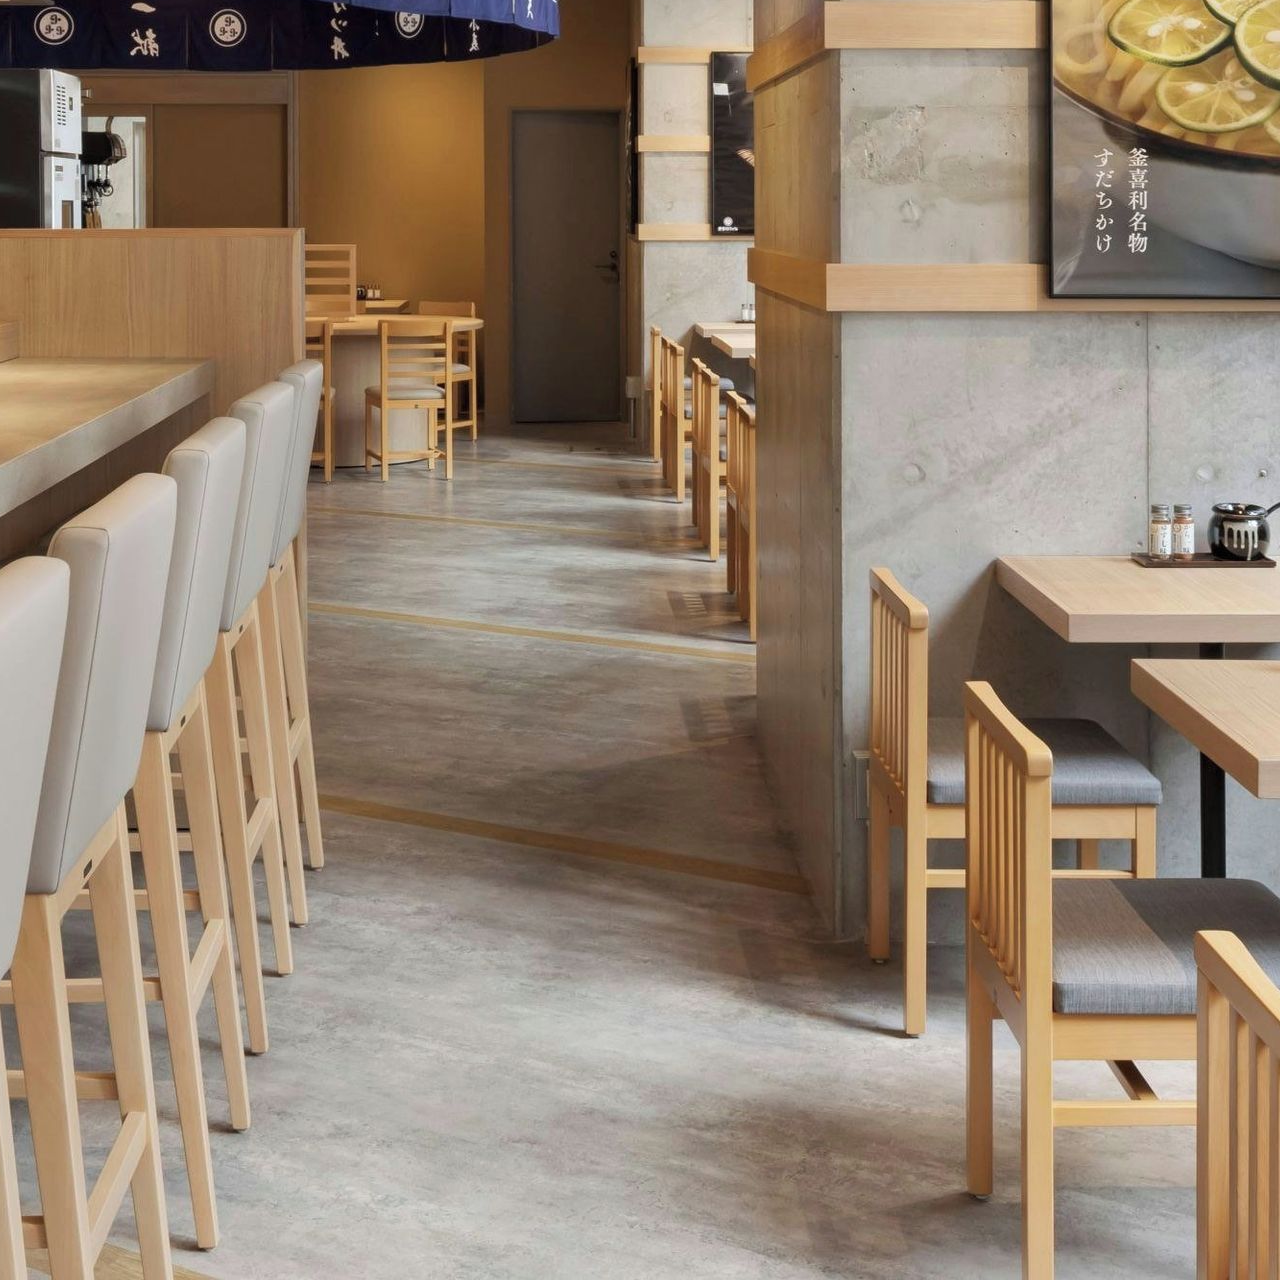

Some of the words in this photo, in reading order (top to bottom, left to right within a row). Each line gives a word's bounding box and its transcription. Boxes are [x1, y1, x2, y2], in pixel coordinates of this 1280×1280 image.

[1093, 147, 1115, 254] すだちかけ
[1126, 147, 1150, 254] 釜喜利名物
